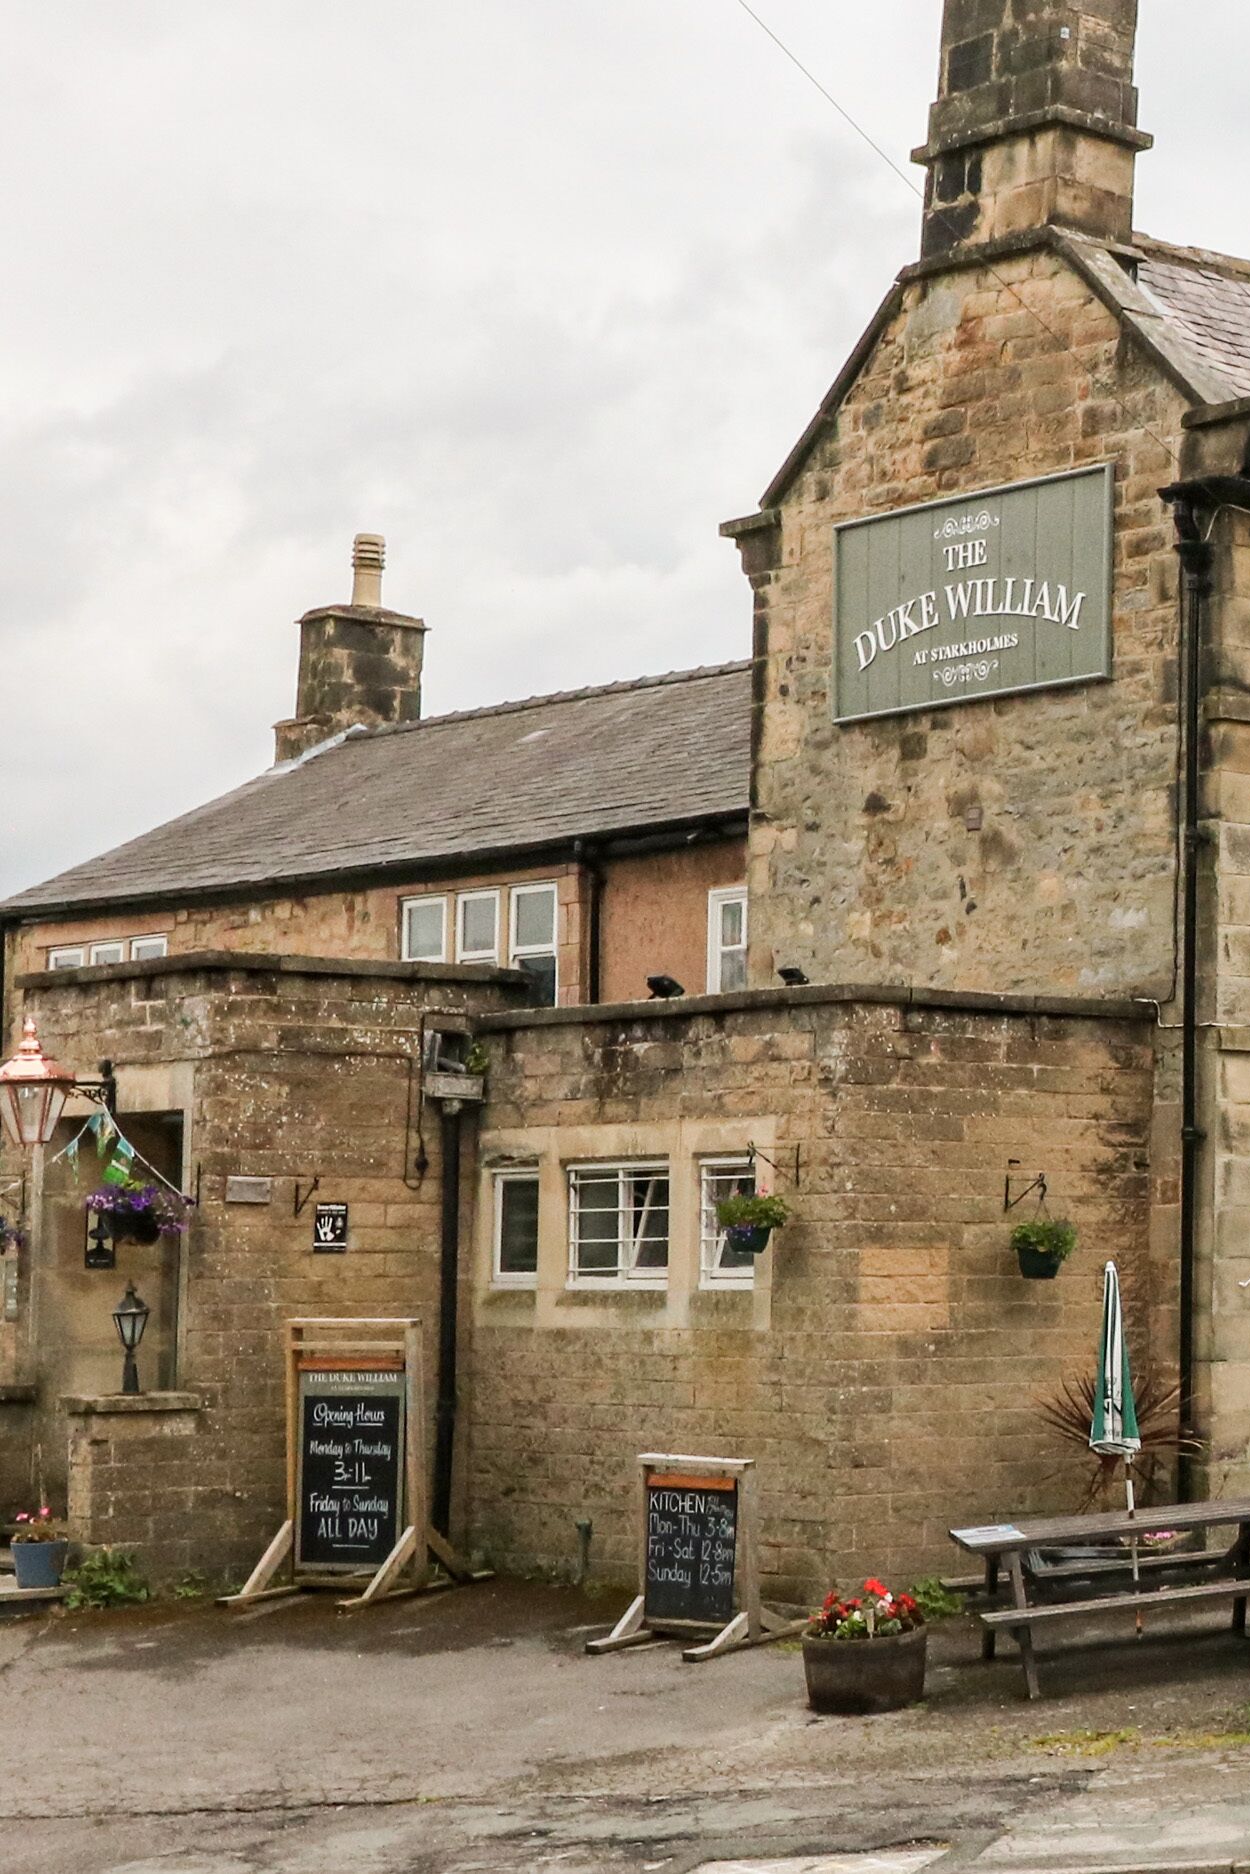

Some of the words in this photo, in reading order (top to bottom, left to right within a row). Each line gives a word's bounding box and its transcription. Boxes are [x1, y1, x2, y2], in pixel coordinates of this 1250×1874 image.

[943, 539, 987, 572] THE
[853, 591, 939, 671] DUKE
[945, 577, 1086, 630] WILLIAM
[913, 650, 930, 665] AT
[930, 633, 1019, 660] STARKHOLMES
[309, 1373, 326, 1383] THE
[328, 1373, 355, 1383] DUKE
[357, 1373, 397, 1383] WILLIAM
[309, 1440, 343, 1459] Monday
[310, 1492, 340, 1517] Friday
[353, 1494, 389, 1519] Sunday
[650, 1492, 705, 1514] KITCHEN
[317, 1517, 342, 1538] ALL
[348, 1517, 378, 1540] DAY
[648, 1559, 692, 1588] Sunday
